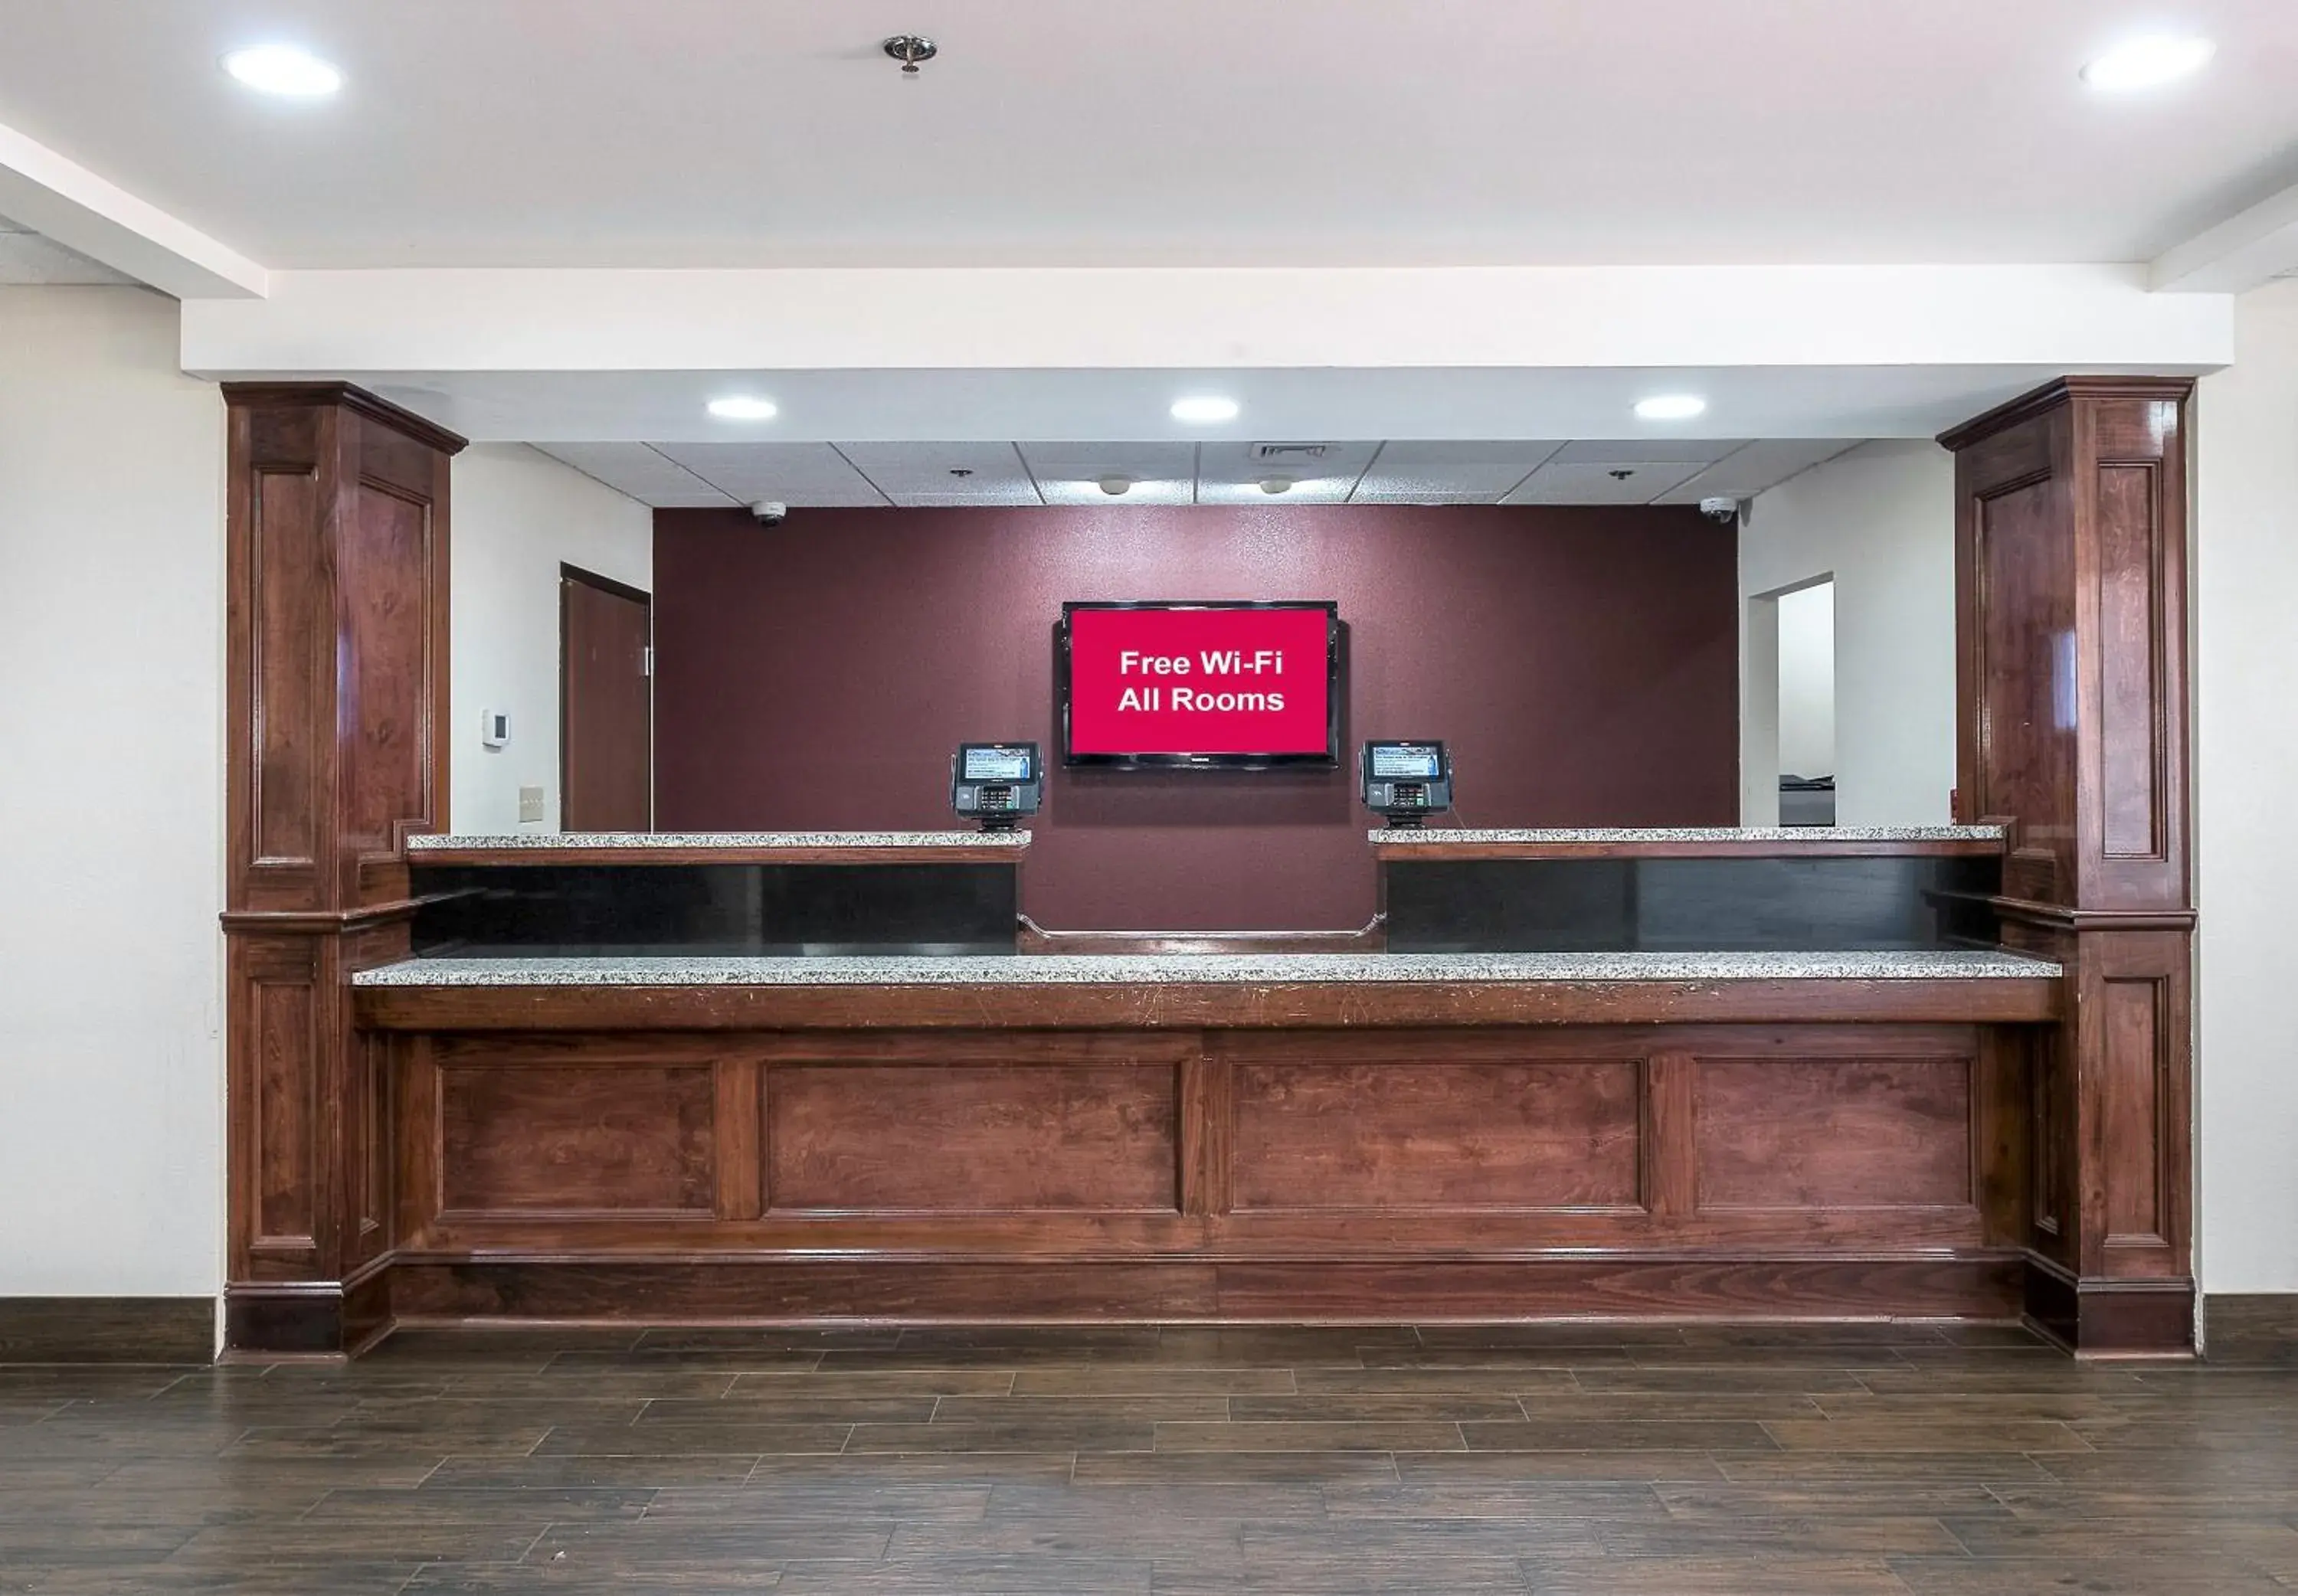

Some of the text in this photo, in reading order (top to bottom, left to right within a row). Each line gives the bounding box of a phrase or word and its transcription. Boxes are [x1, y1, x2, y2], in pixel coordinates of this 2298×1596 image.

[1120, 650, 1283, 675] Free Wi-Fi
[1118, 687, 1285, 711] All Rooms
